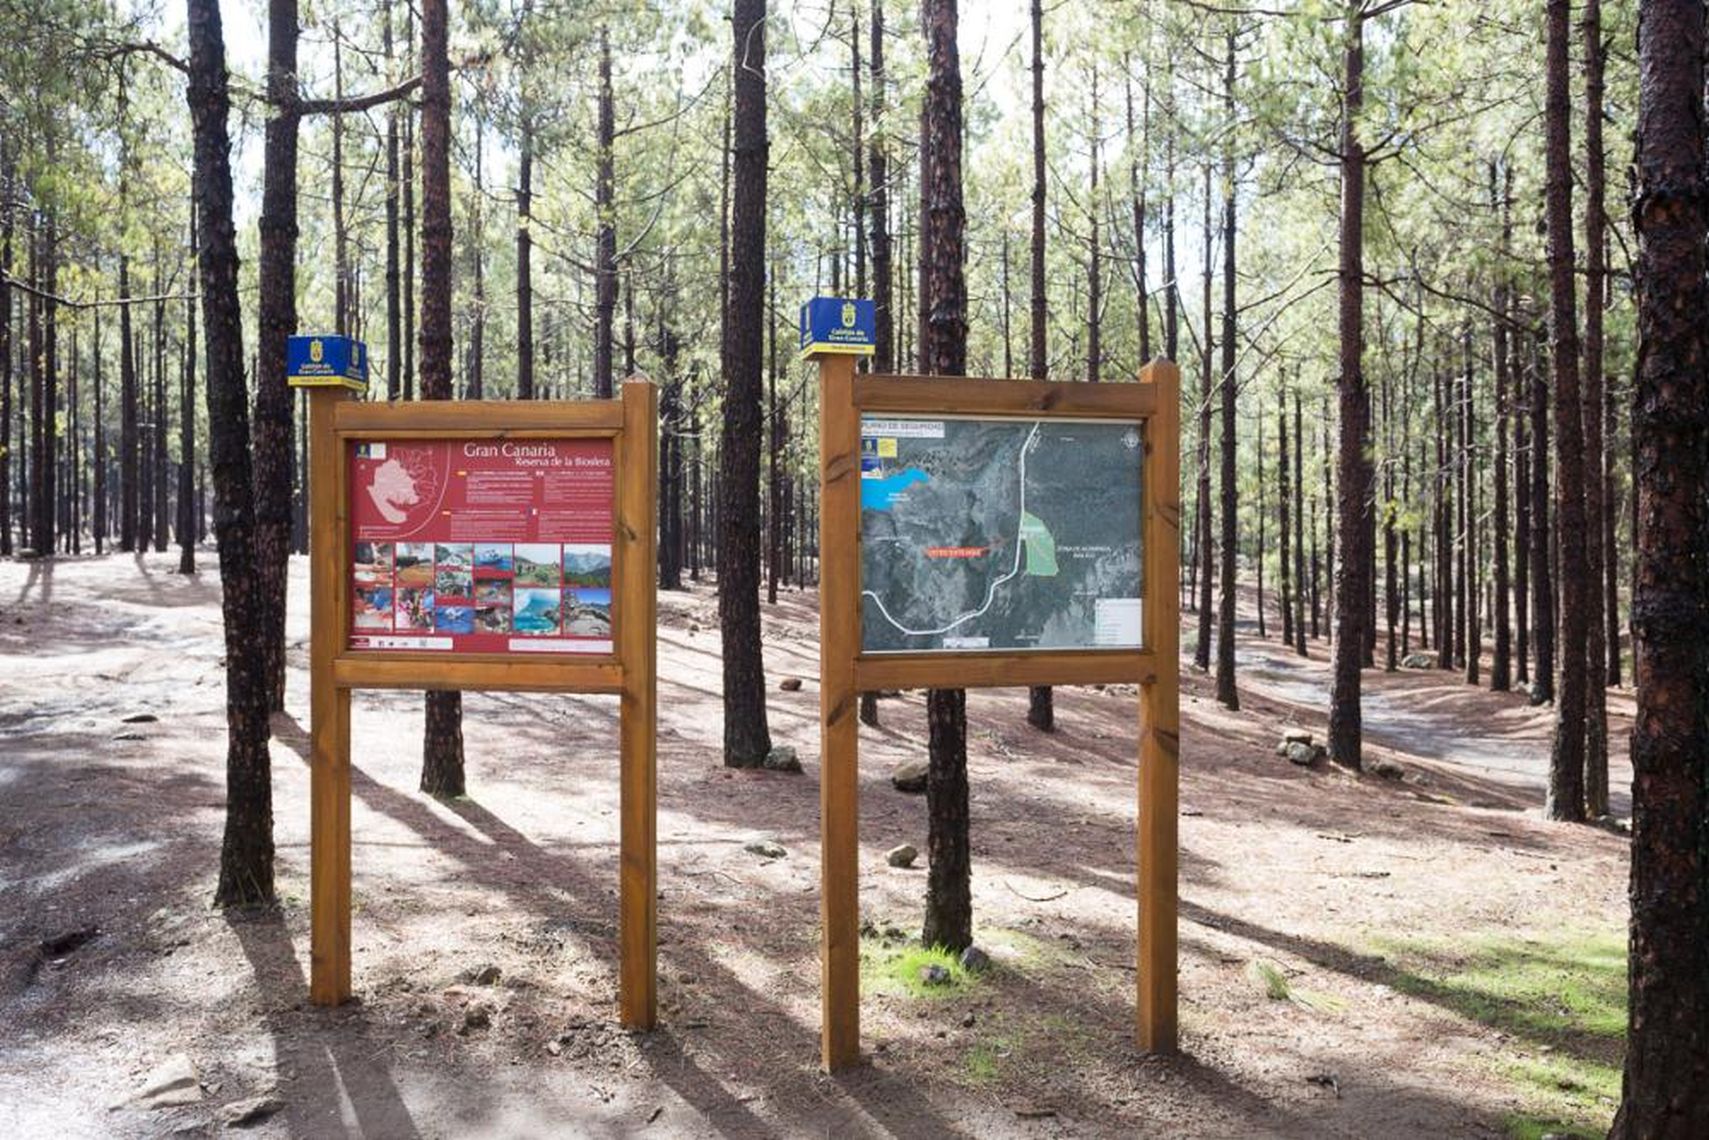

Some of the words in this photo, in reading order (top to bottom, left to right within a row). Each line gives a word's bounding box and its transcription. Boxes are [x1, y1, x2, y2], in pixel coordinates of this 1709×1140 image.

[463, 442, 498, 457] Gran
[501, 442, 556, 457] Canaria
[515, 457, 549, 466] Reserva
[551, 457, 562, 466] de
[564, 457, 572, 466] la
[574, 457, 611, 467] Biosfera
